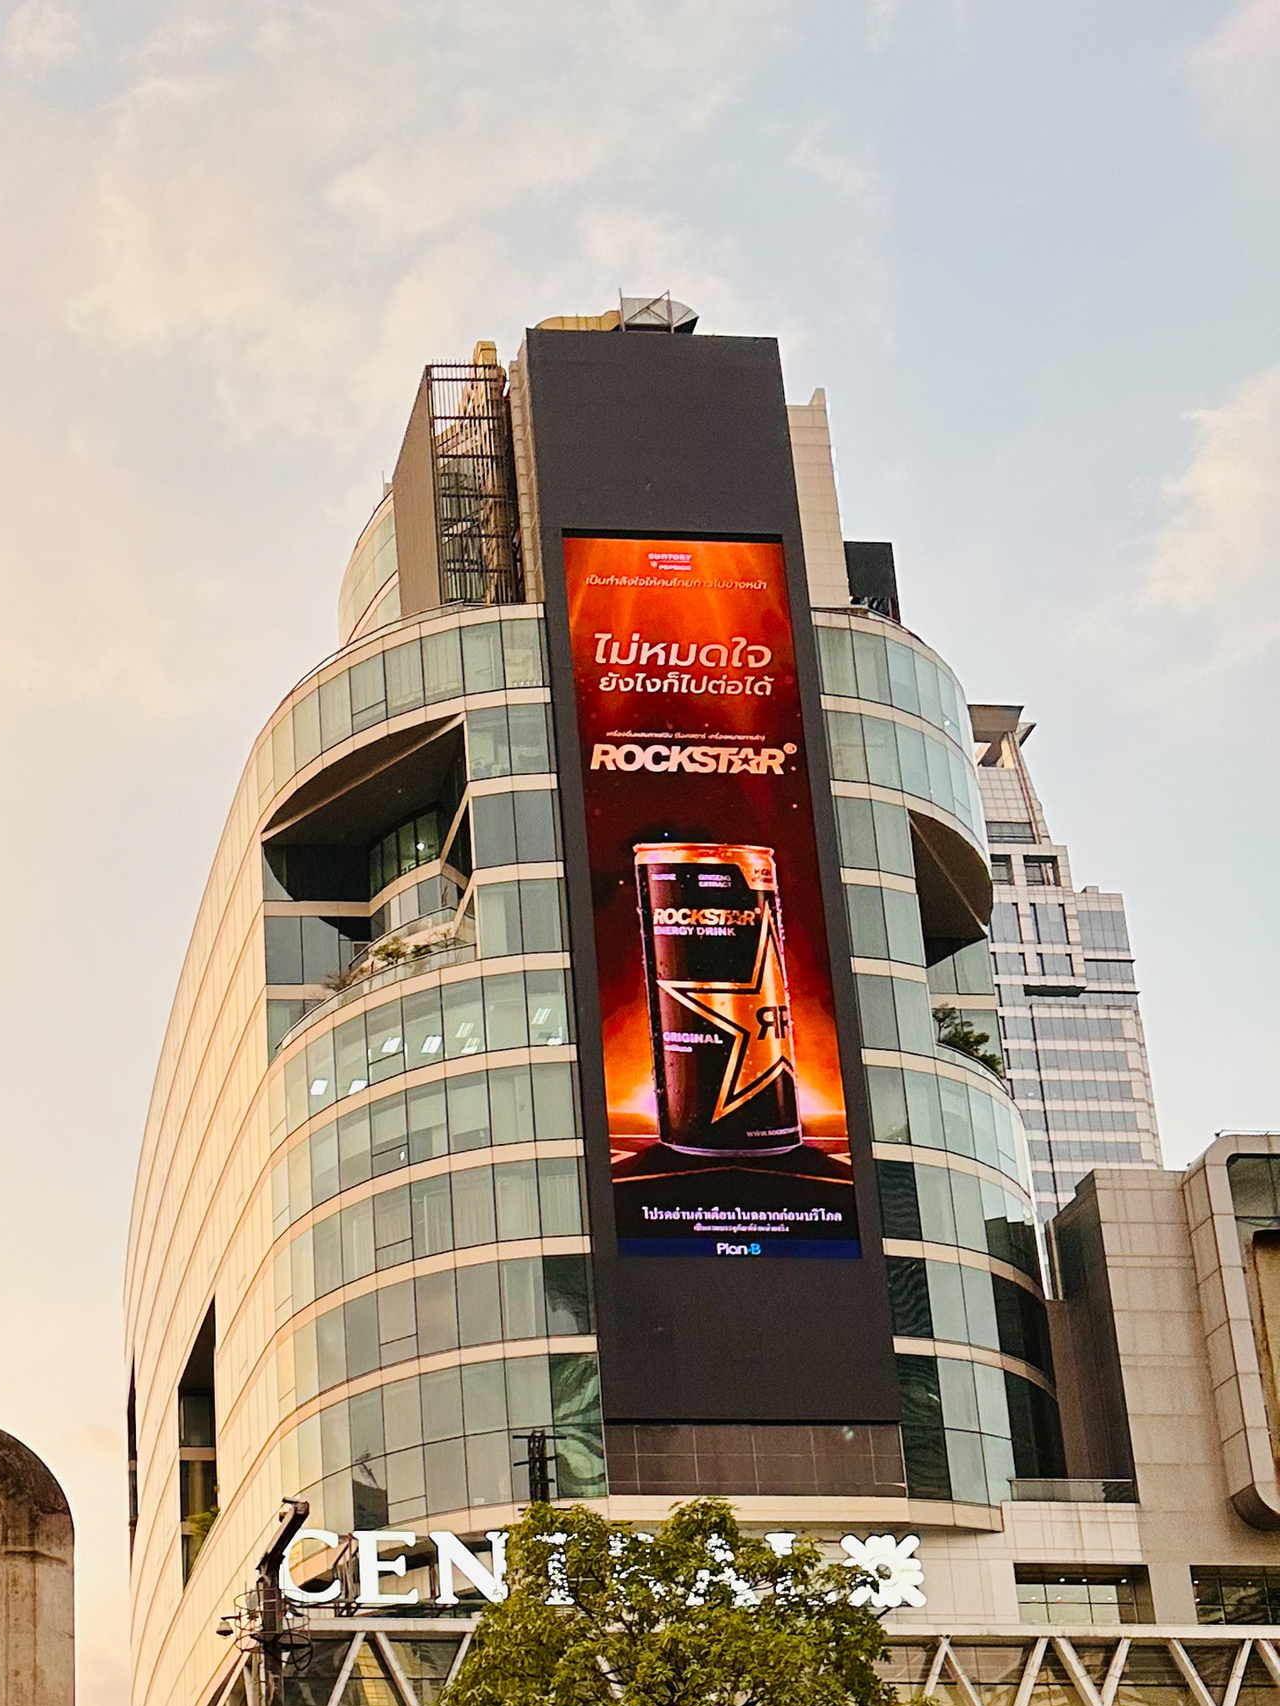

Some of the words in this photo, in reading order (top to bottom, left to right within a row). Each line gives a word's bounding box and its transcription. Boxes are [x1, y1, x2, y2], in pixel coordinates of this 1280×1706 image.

[594, 633, 772, 668] ไม่หมดใจ
[598, 672, 775, 696] ยังไงก็ไปต่อได้
[590, 743, 786, 775] ROCKSTAR
[652, 907, 756, 926] ROCKSTAR
[654, 925, 694, 936] ENERGY
[696, 926, 737, 937] DRINK
[663, 1031, 723, 1044] ORIGINAL
